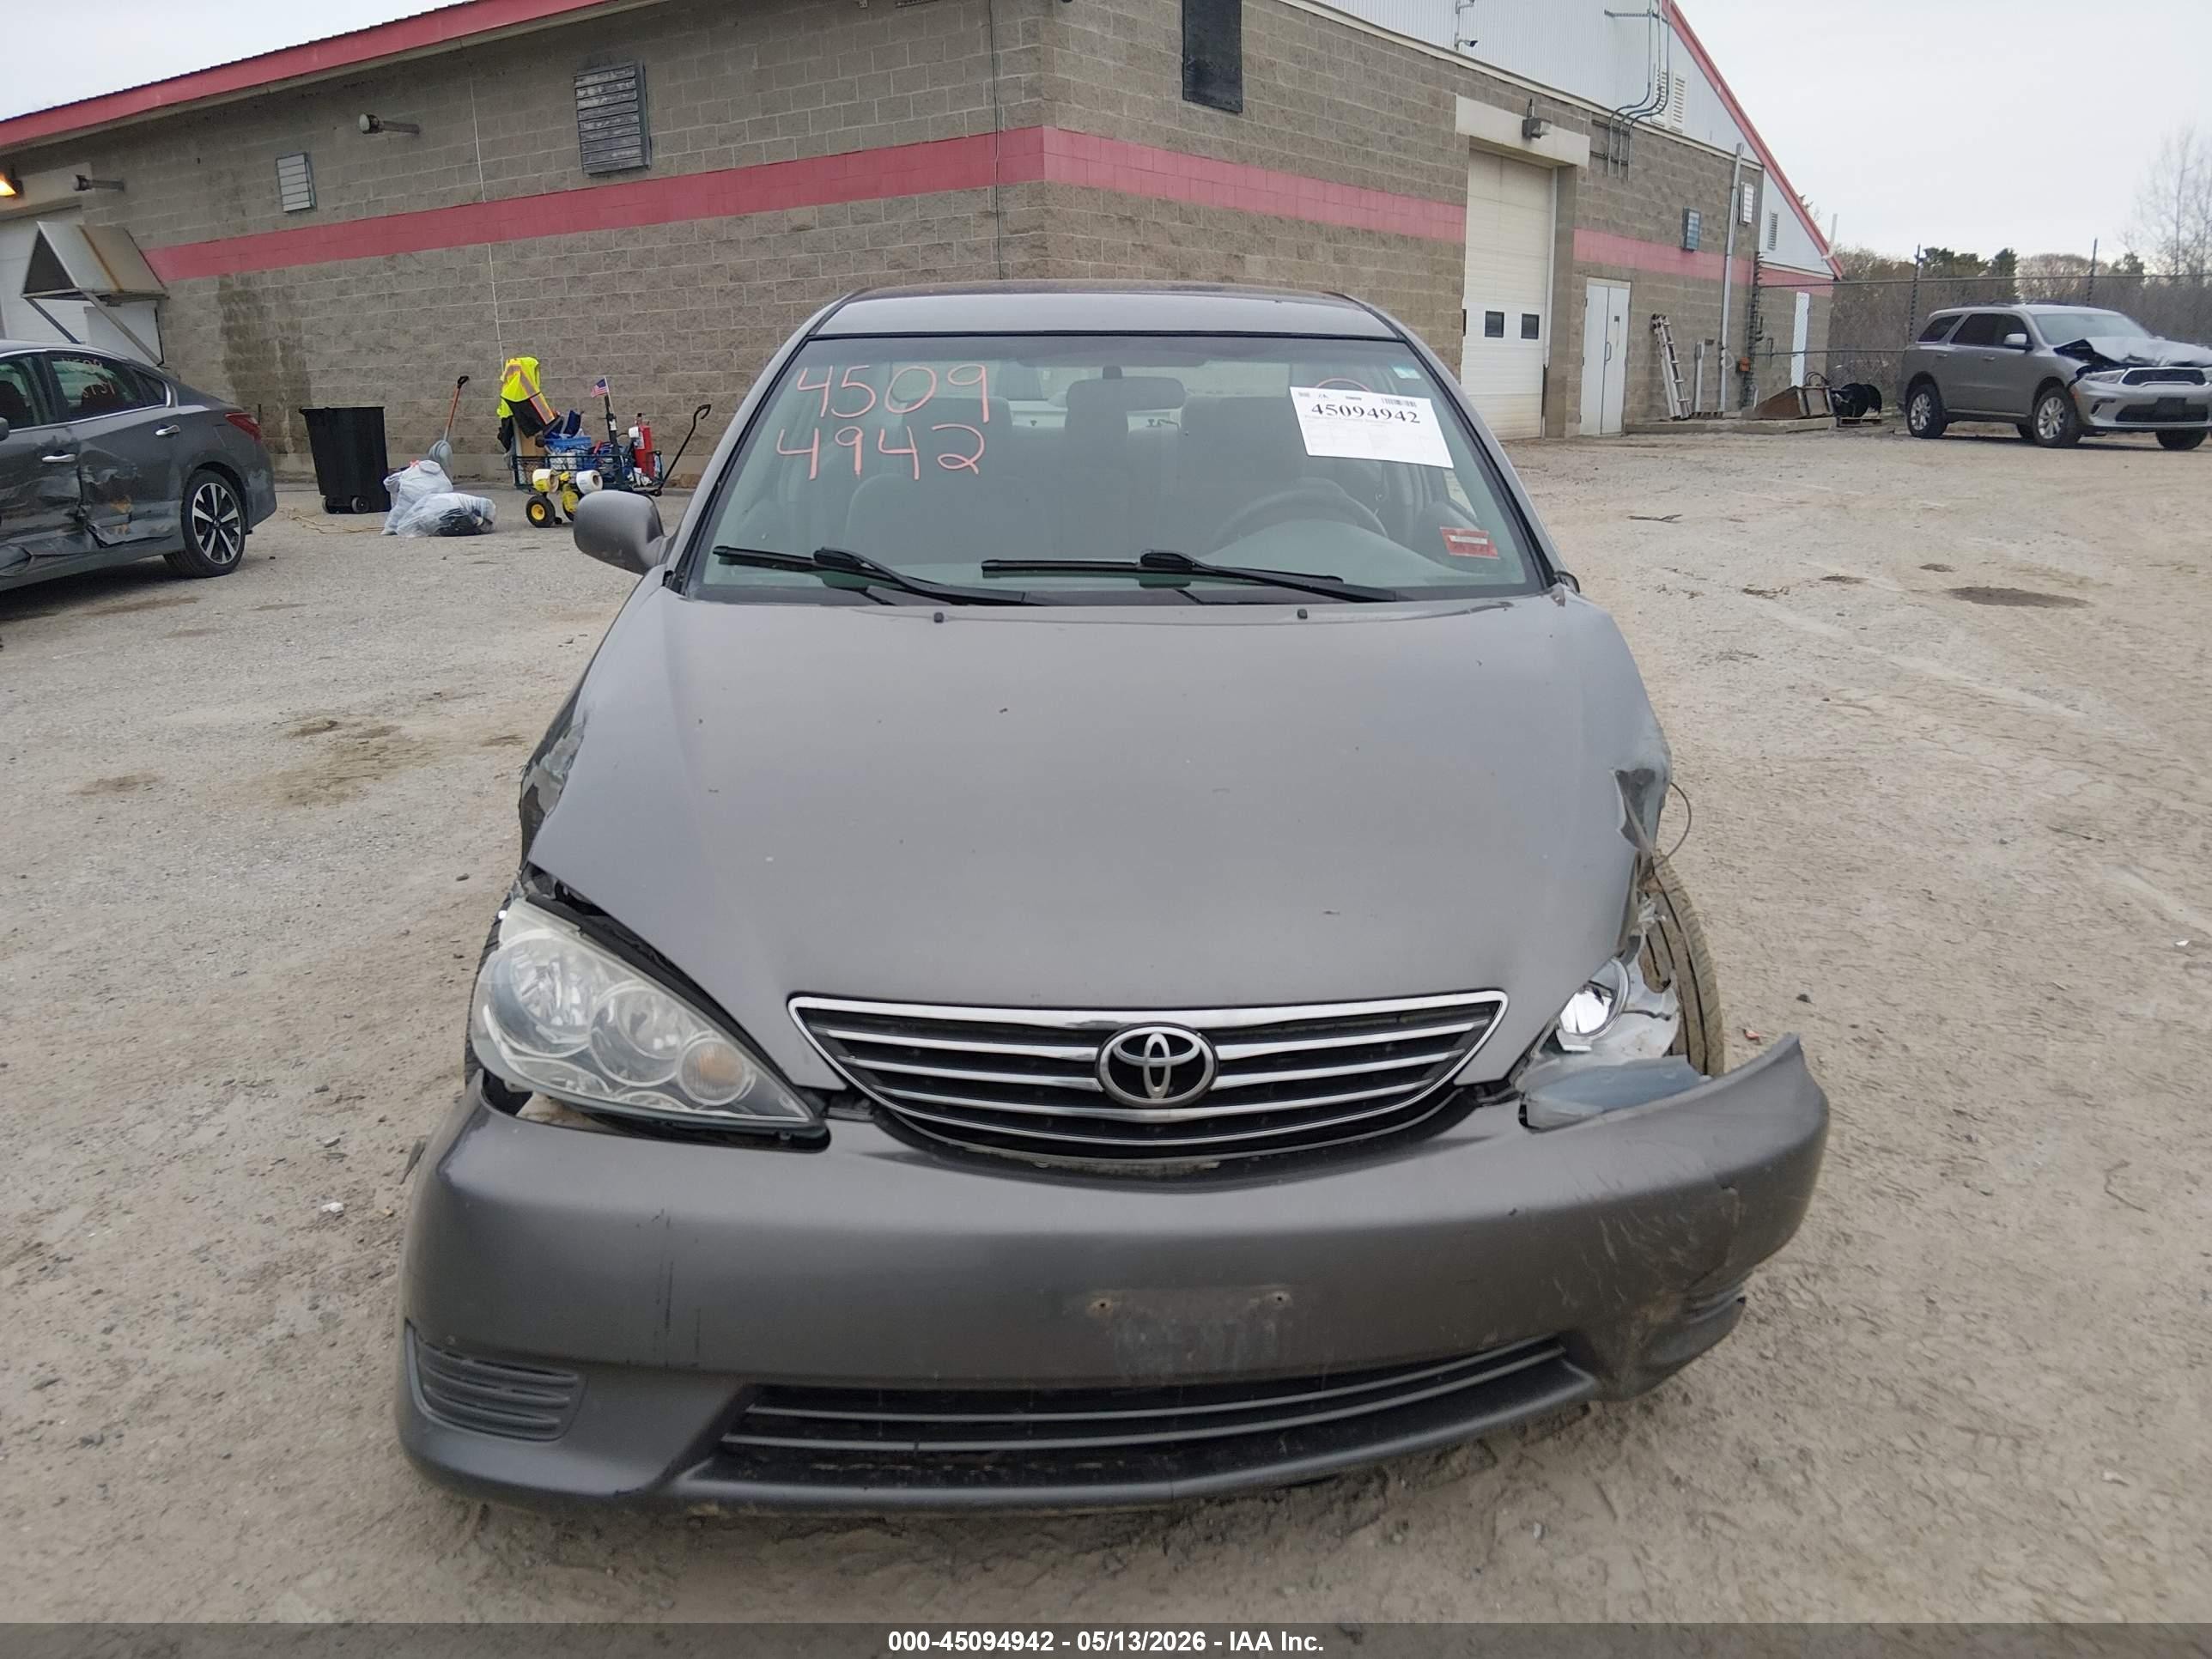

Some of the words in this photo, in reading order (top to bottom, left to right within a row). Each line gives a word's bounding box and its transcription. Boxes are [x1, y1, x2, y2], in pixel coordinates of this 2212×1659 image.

[797, 363, 989, 422] 4509
[1311, 403, 1421, 424] 45094942
[776, 423, 985, 480] 4942
